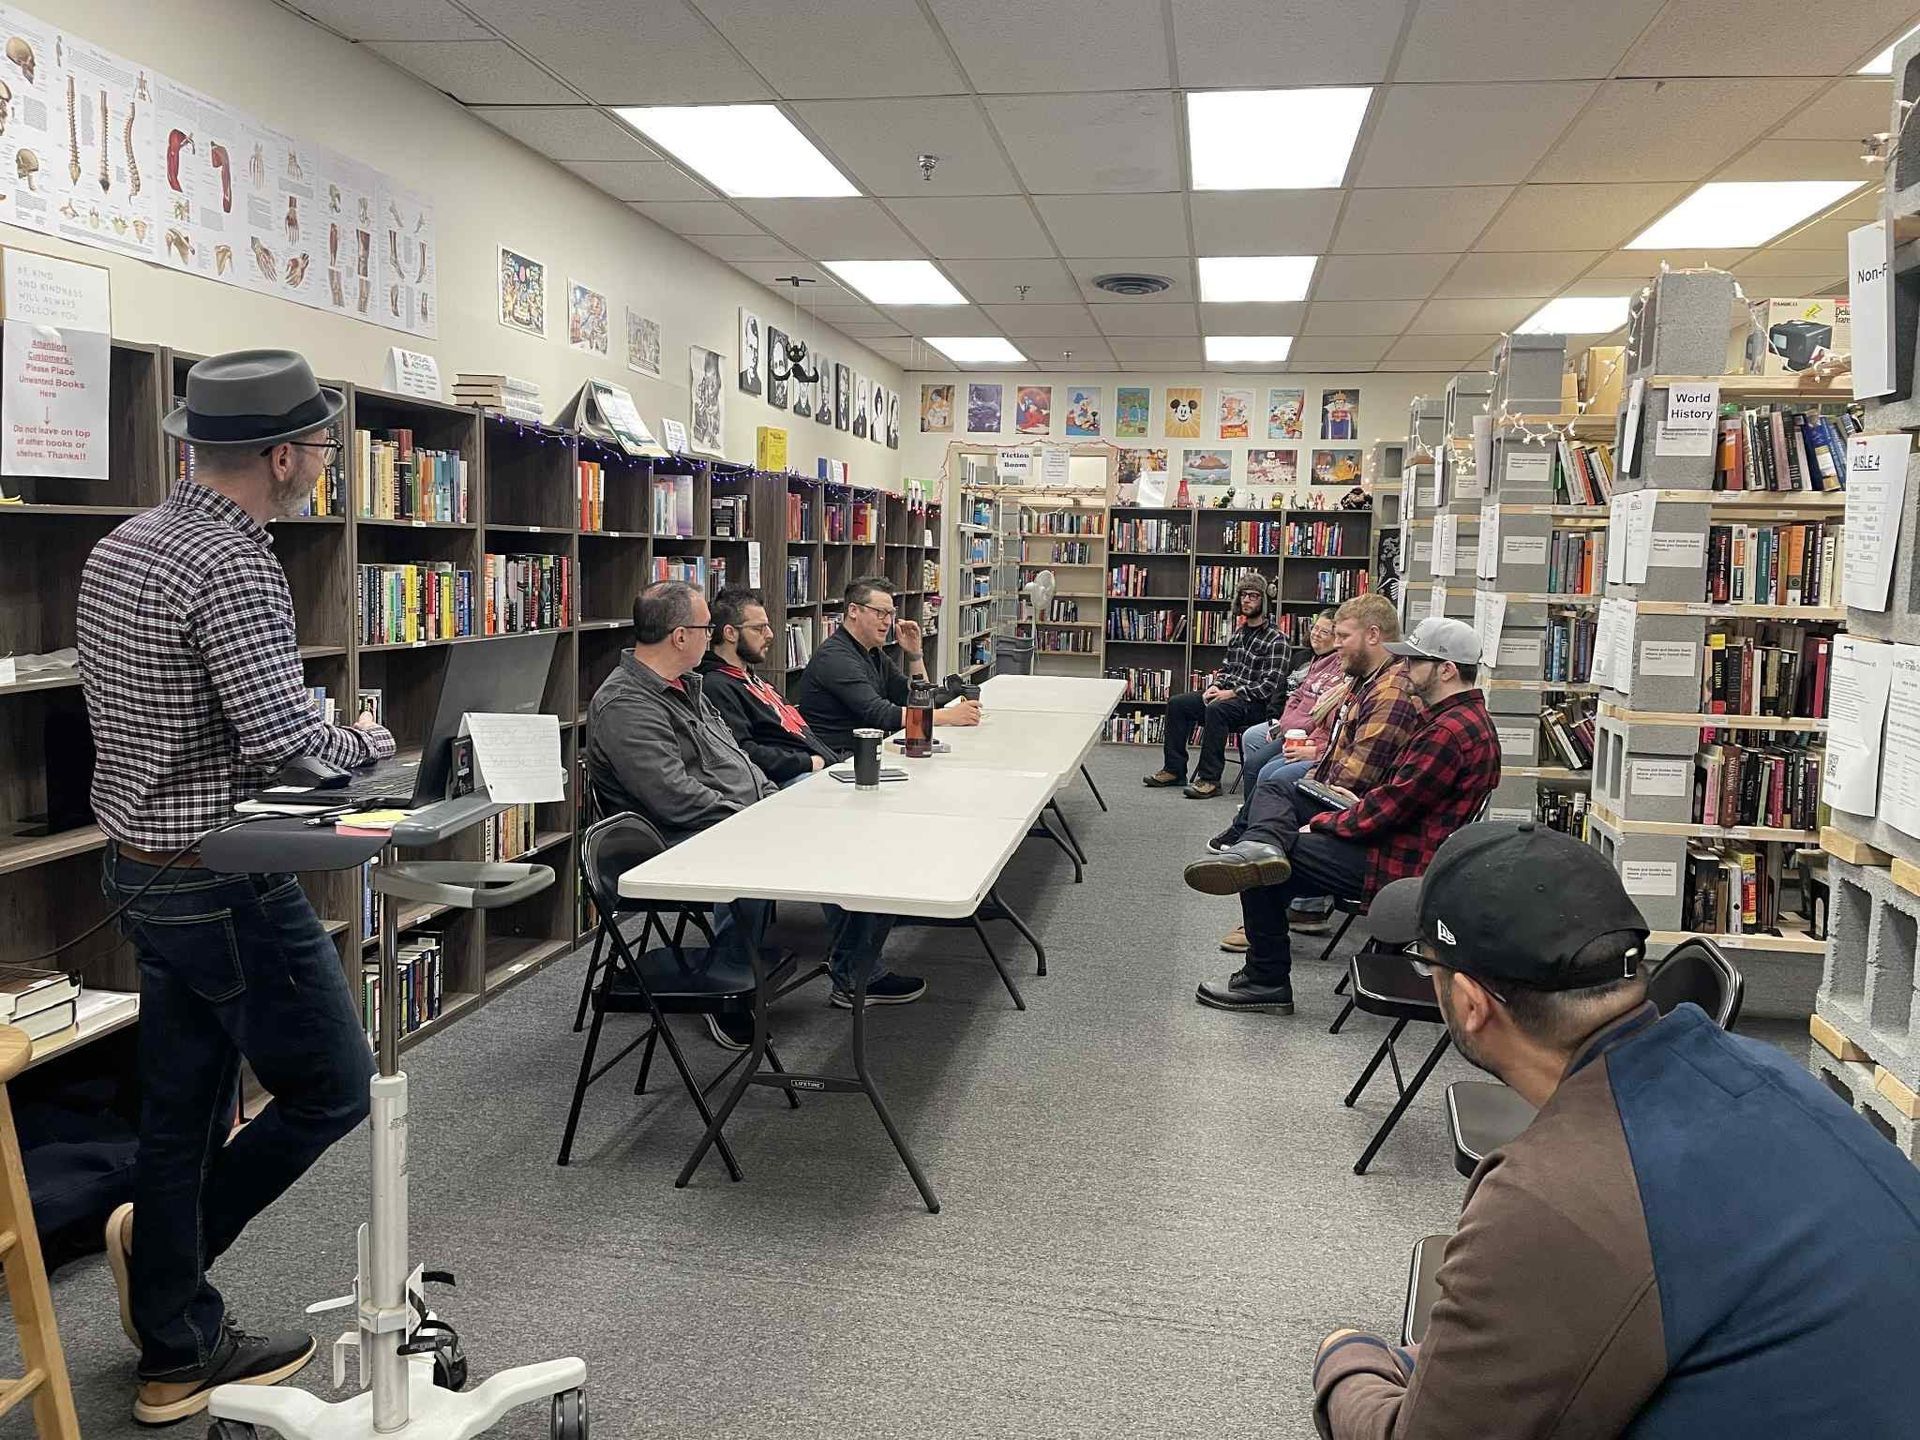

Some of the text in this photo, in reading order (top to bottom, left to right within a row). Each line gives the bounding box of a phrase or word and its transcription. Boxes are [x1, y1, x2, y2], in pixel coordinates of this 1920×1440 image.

[51, 366, 75, 376] Place
[55, 379, 86, 389] Books
[39, 389, 57, 398] Here
[1675, 393, 1711, 403] World
[1671, 409, 1713, 421] History
[13, 424, 23, 433] Do
[25, 426, 37, 434] not
[75, 429, 91, 439] top
[45, 440, 73, 448] books
[75, 441, 86, 449] or
[1853, 454, 1881, 469] AISLE 4
[1825, 540, 1834, 562] LAND
